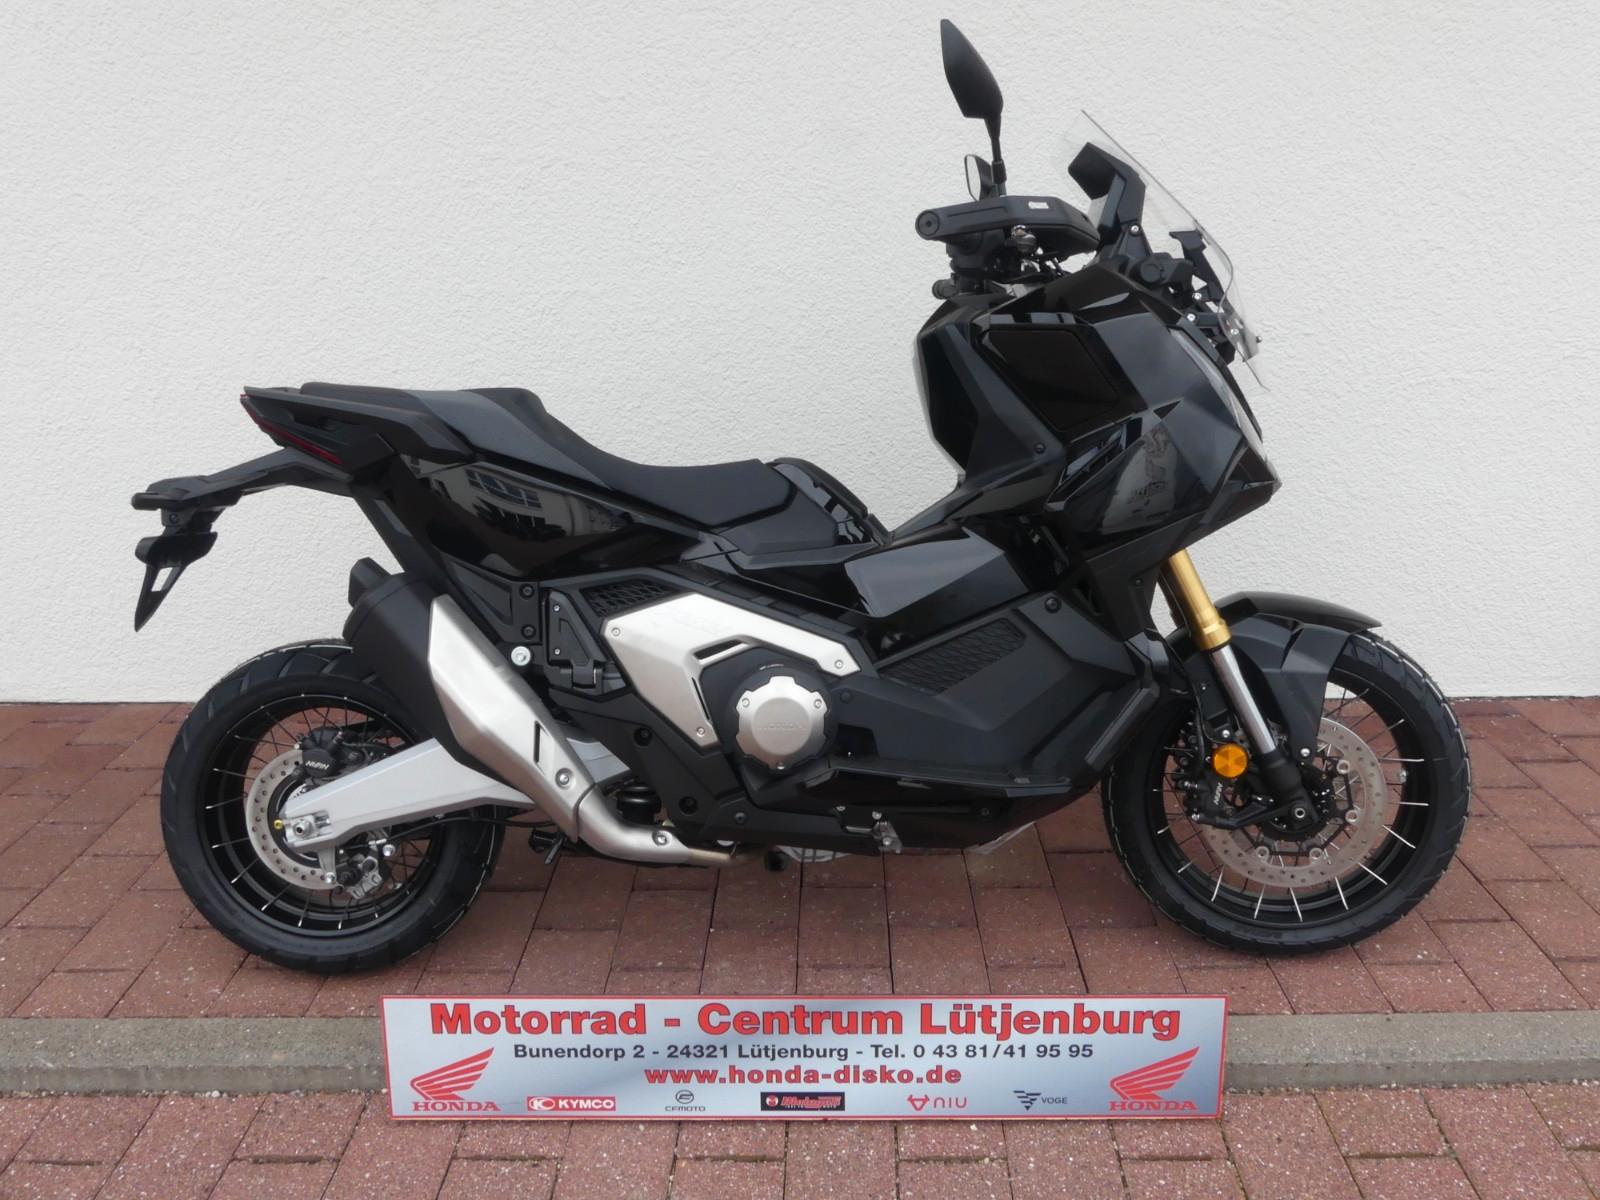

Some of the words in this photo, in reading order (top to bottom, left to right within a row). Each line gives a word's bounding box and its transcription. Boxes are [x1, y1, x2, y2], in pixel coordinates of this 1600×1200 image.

[430, 1002, 646, 1035] Motorrad
[698, 1002, 903, 1036] Centrum
[920, 1002, 1180, 1041] Lütjenburg
[514, 1044, 626, 1061] Bunendorp
[633, 1045, 645, 1058] 2
[667, 1044, 729, 1058] 24321
[738, 1044, 849, 1061] Lütjenburg
[870, 1044, 905, 1058] Tel.
[913, 1044, 925, 1058] 0
[932, 1044, 958, 1058] 43
[965, 1044, 1030, 1059] 81/41
[1036, 1044, 1061, 1058] 95
[1068, 1044, 1093, 1058] 95
[645, 1065, 962, 1084] www.honda-disko.de
[412, 1100, 500, 1112] HONDA
[558, 1098, 615, 1109] KYMCO
[1041, 1096, 1068, 1105] VOGE
[1109, 1100, 1197, 1112] HONDA
